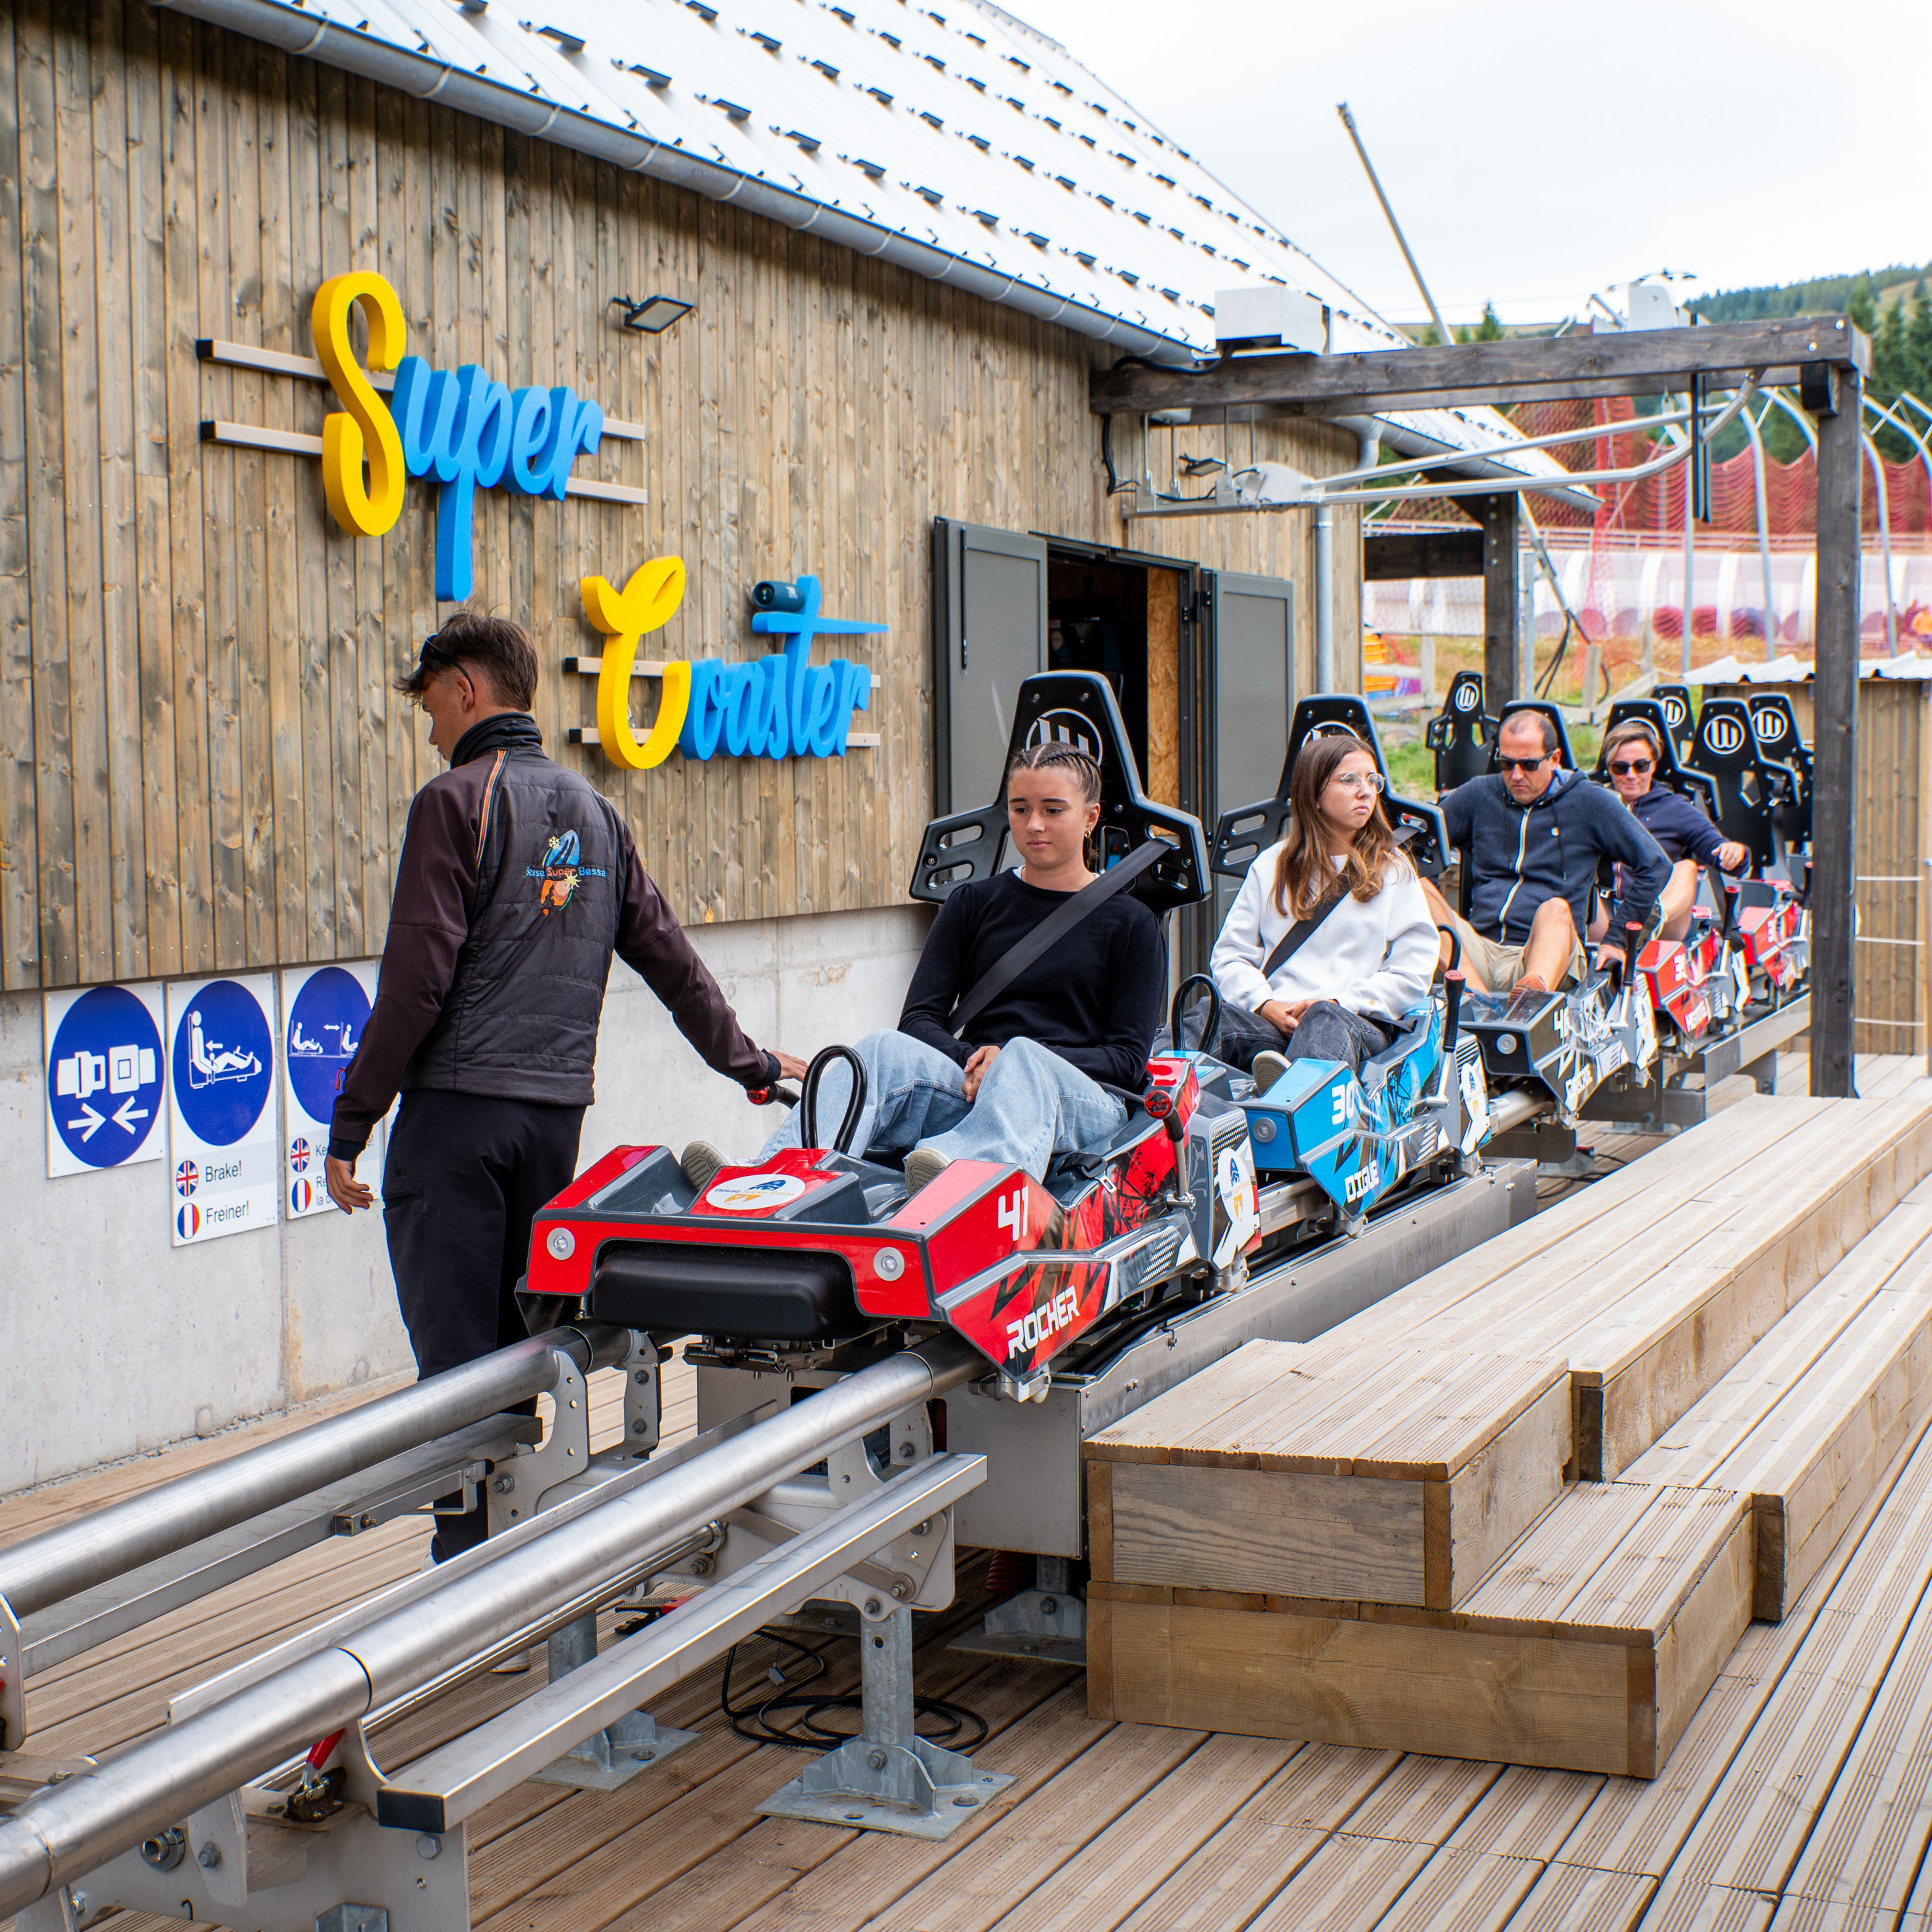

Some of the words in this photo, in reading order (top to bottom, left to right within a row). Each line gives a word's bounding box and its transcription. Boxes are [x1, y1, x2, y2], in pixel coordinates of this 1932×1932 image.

[312, 270, 603, 602] Super
[581, 555, 889, 770] Coaster
[526, 866, 545, 877] Besse
[546, 866, 576, 878] Super
[579, 866, 606, 877] Besse
[1332, 1079, 1355, 1126] 30
[205, 1161, 242, 1183] Brake!
[1344, 1159, 1381, 1203] DIGUE
[206, 1199, 250, 1224] Freiner!
[998, 1185, 1028, 1242] 41
[1006, 1285, 1080, 1360] ROCHER
